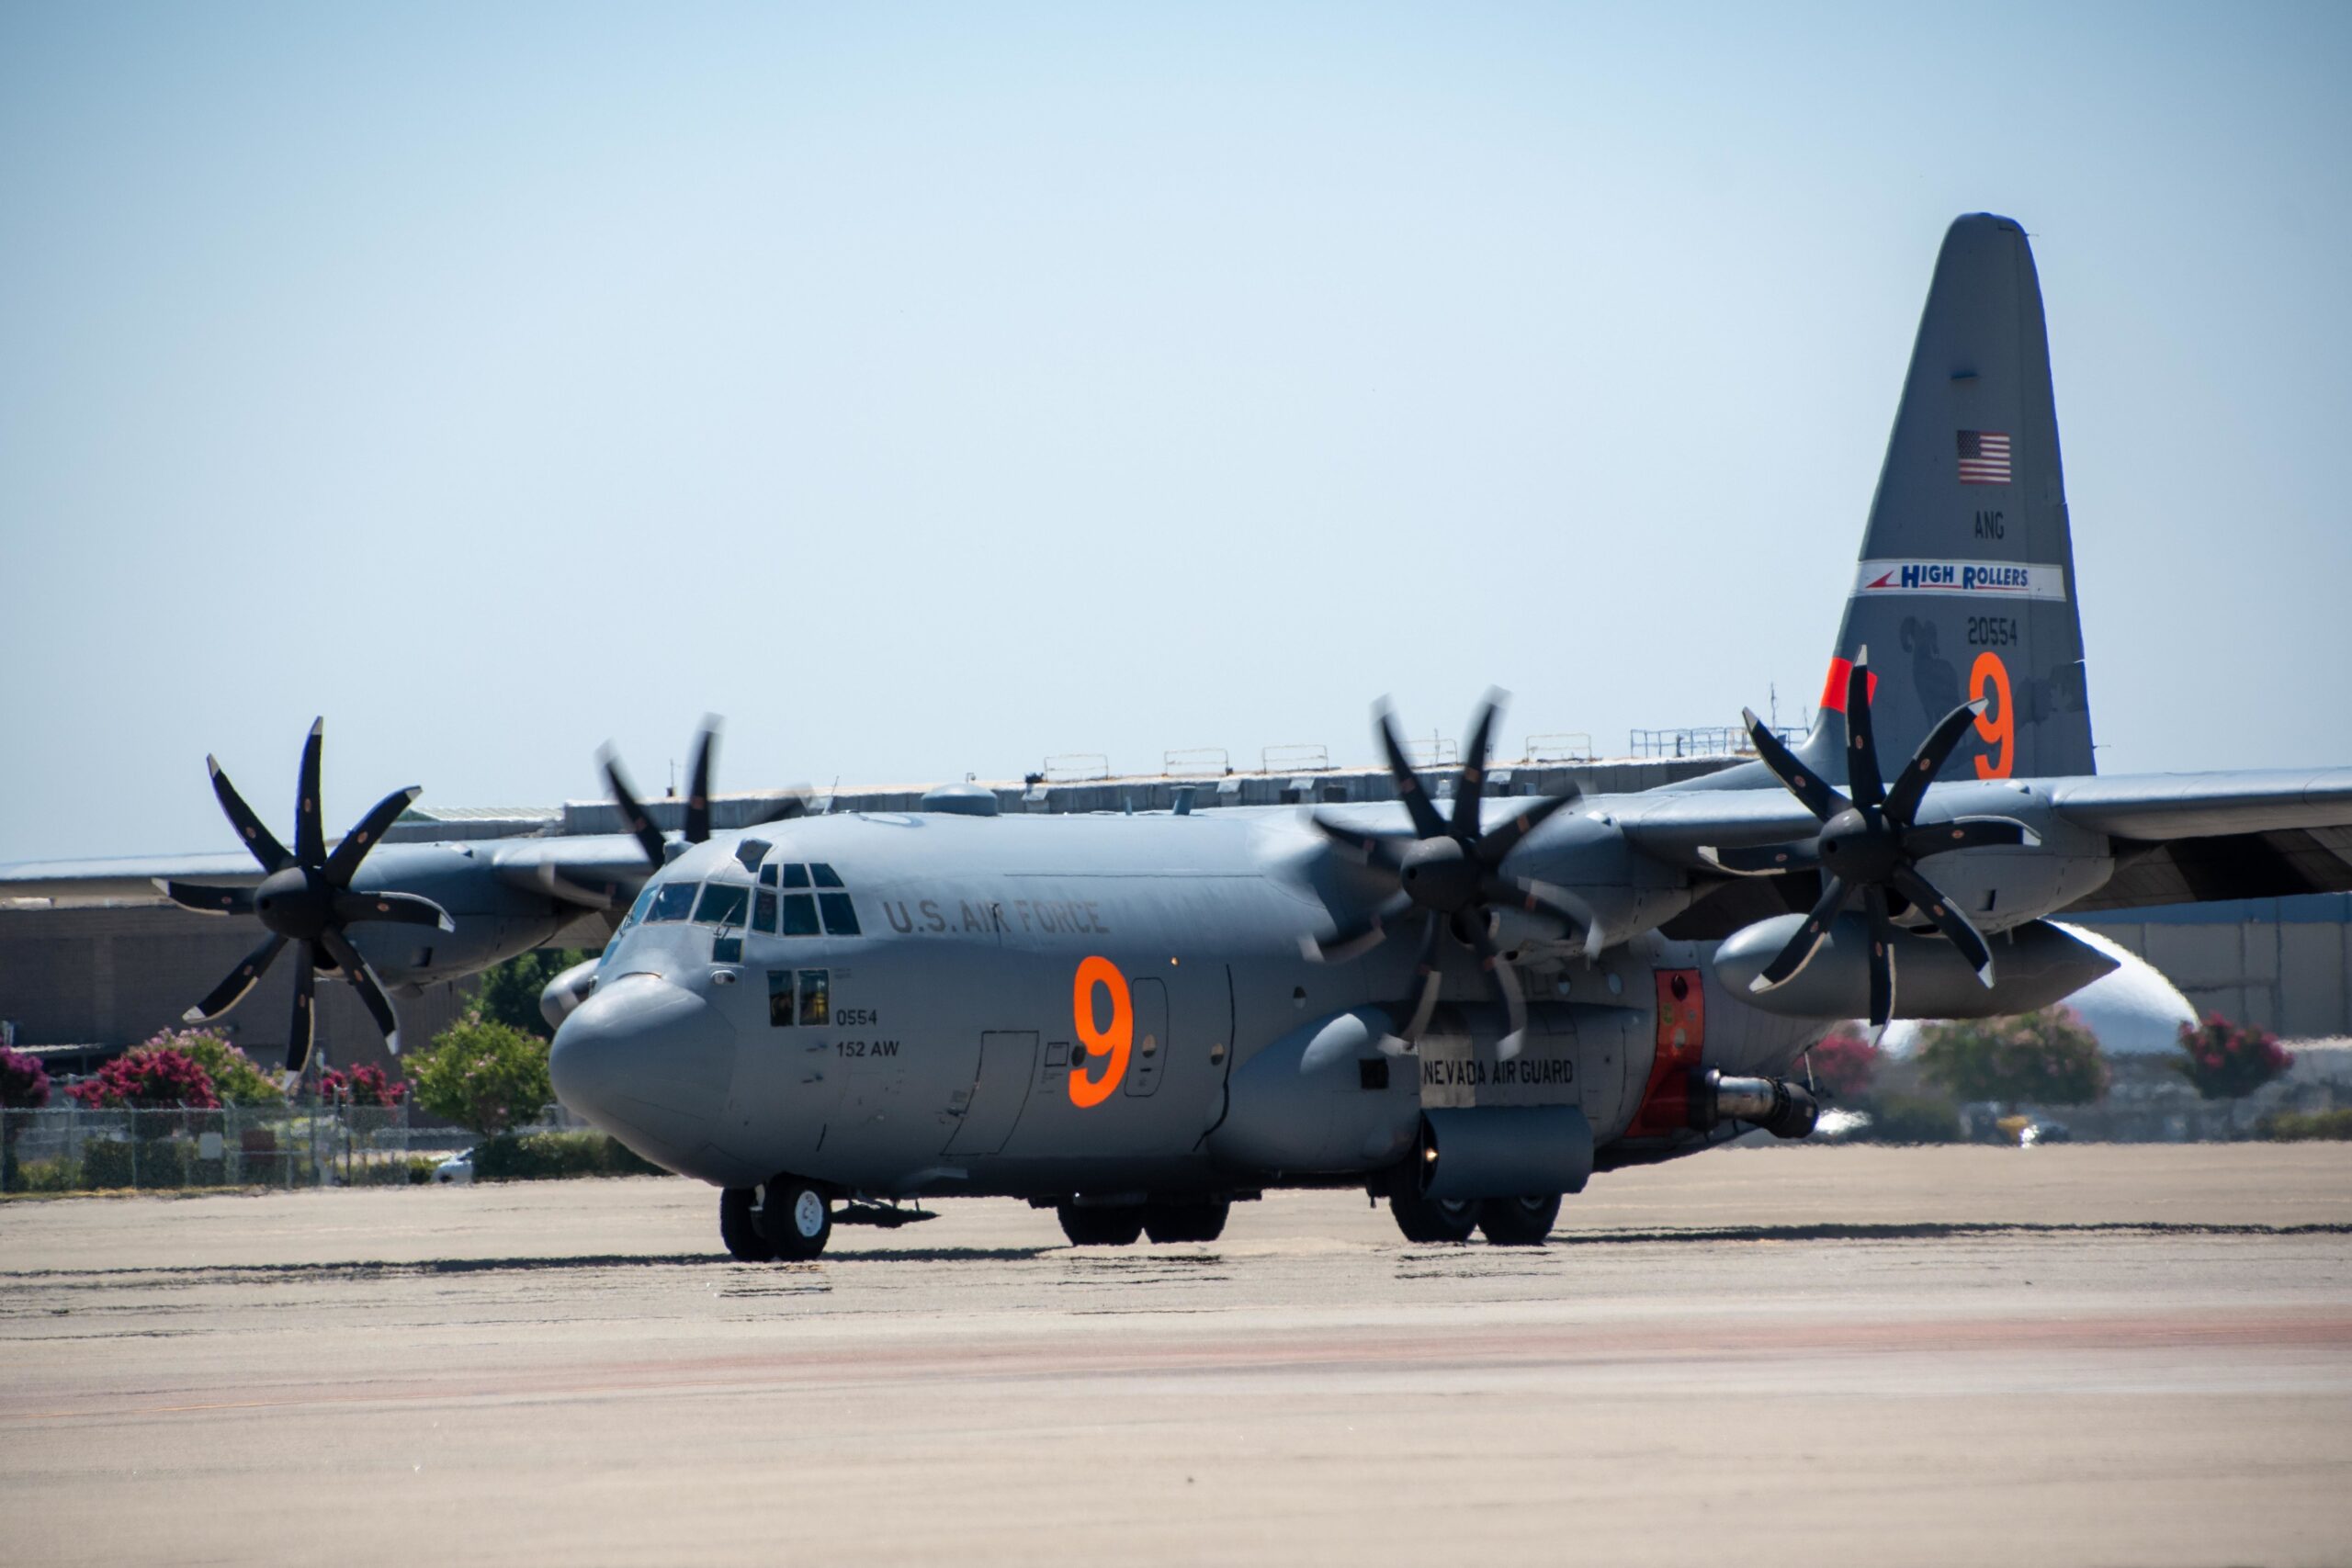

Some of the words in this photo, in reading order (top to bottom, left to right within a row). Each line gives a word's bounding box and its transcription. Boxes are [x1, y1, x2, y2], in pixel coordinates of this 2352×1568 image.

[1974, 511, 2005, 540] ANG
[1901, 564, 1954, 589] HIGH
[1962, 566, 2029, 590] ROLLERS
[1967, 616, 2018, 647] 20554
[1969, 651, 2015, 781] 9
[959, 899, 1012, 933] AIR
[1013, 899, 1110, 934] FORCE
[836, 1010, 877, 1026] 0554
[1069, 955, 1134, 1109] 9
[836, 1041, 865, 1057] 152
[870, 1040, 899, 1057] AW
[1423, 1060, 1487, 1086] NEVADA
[1492, 1060, 1516, 1086] AIR
[1520, 1059, 1574, 1085] GUARD
